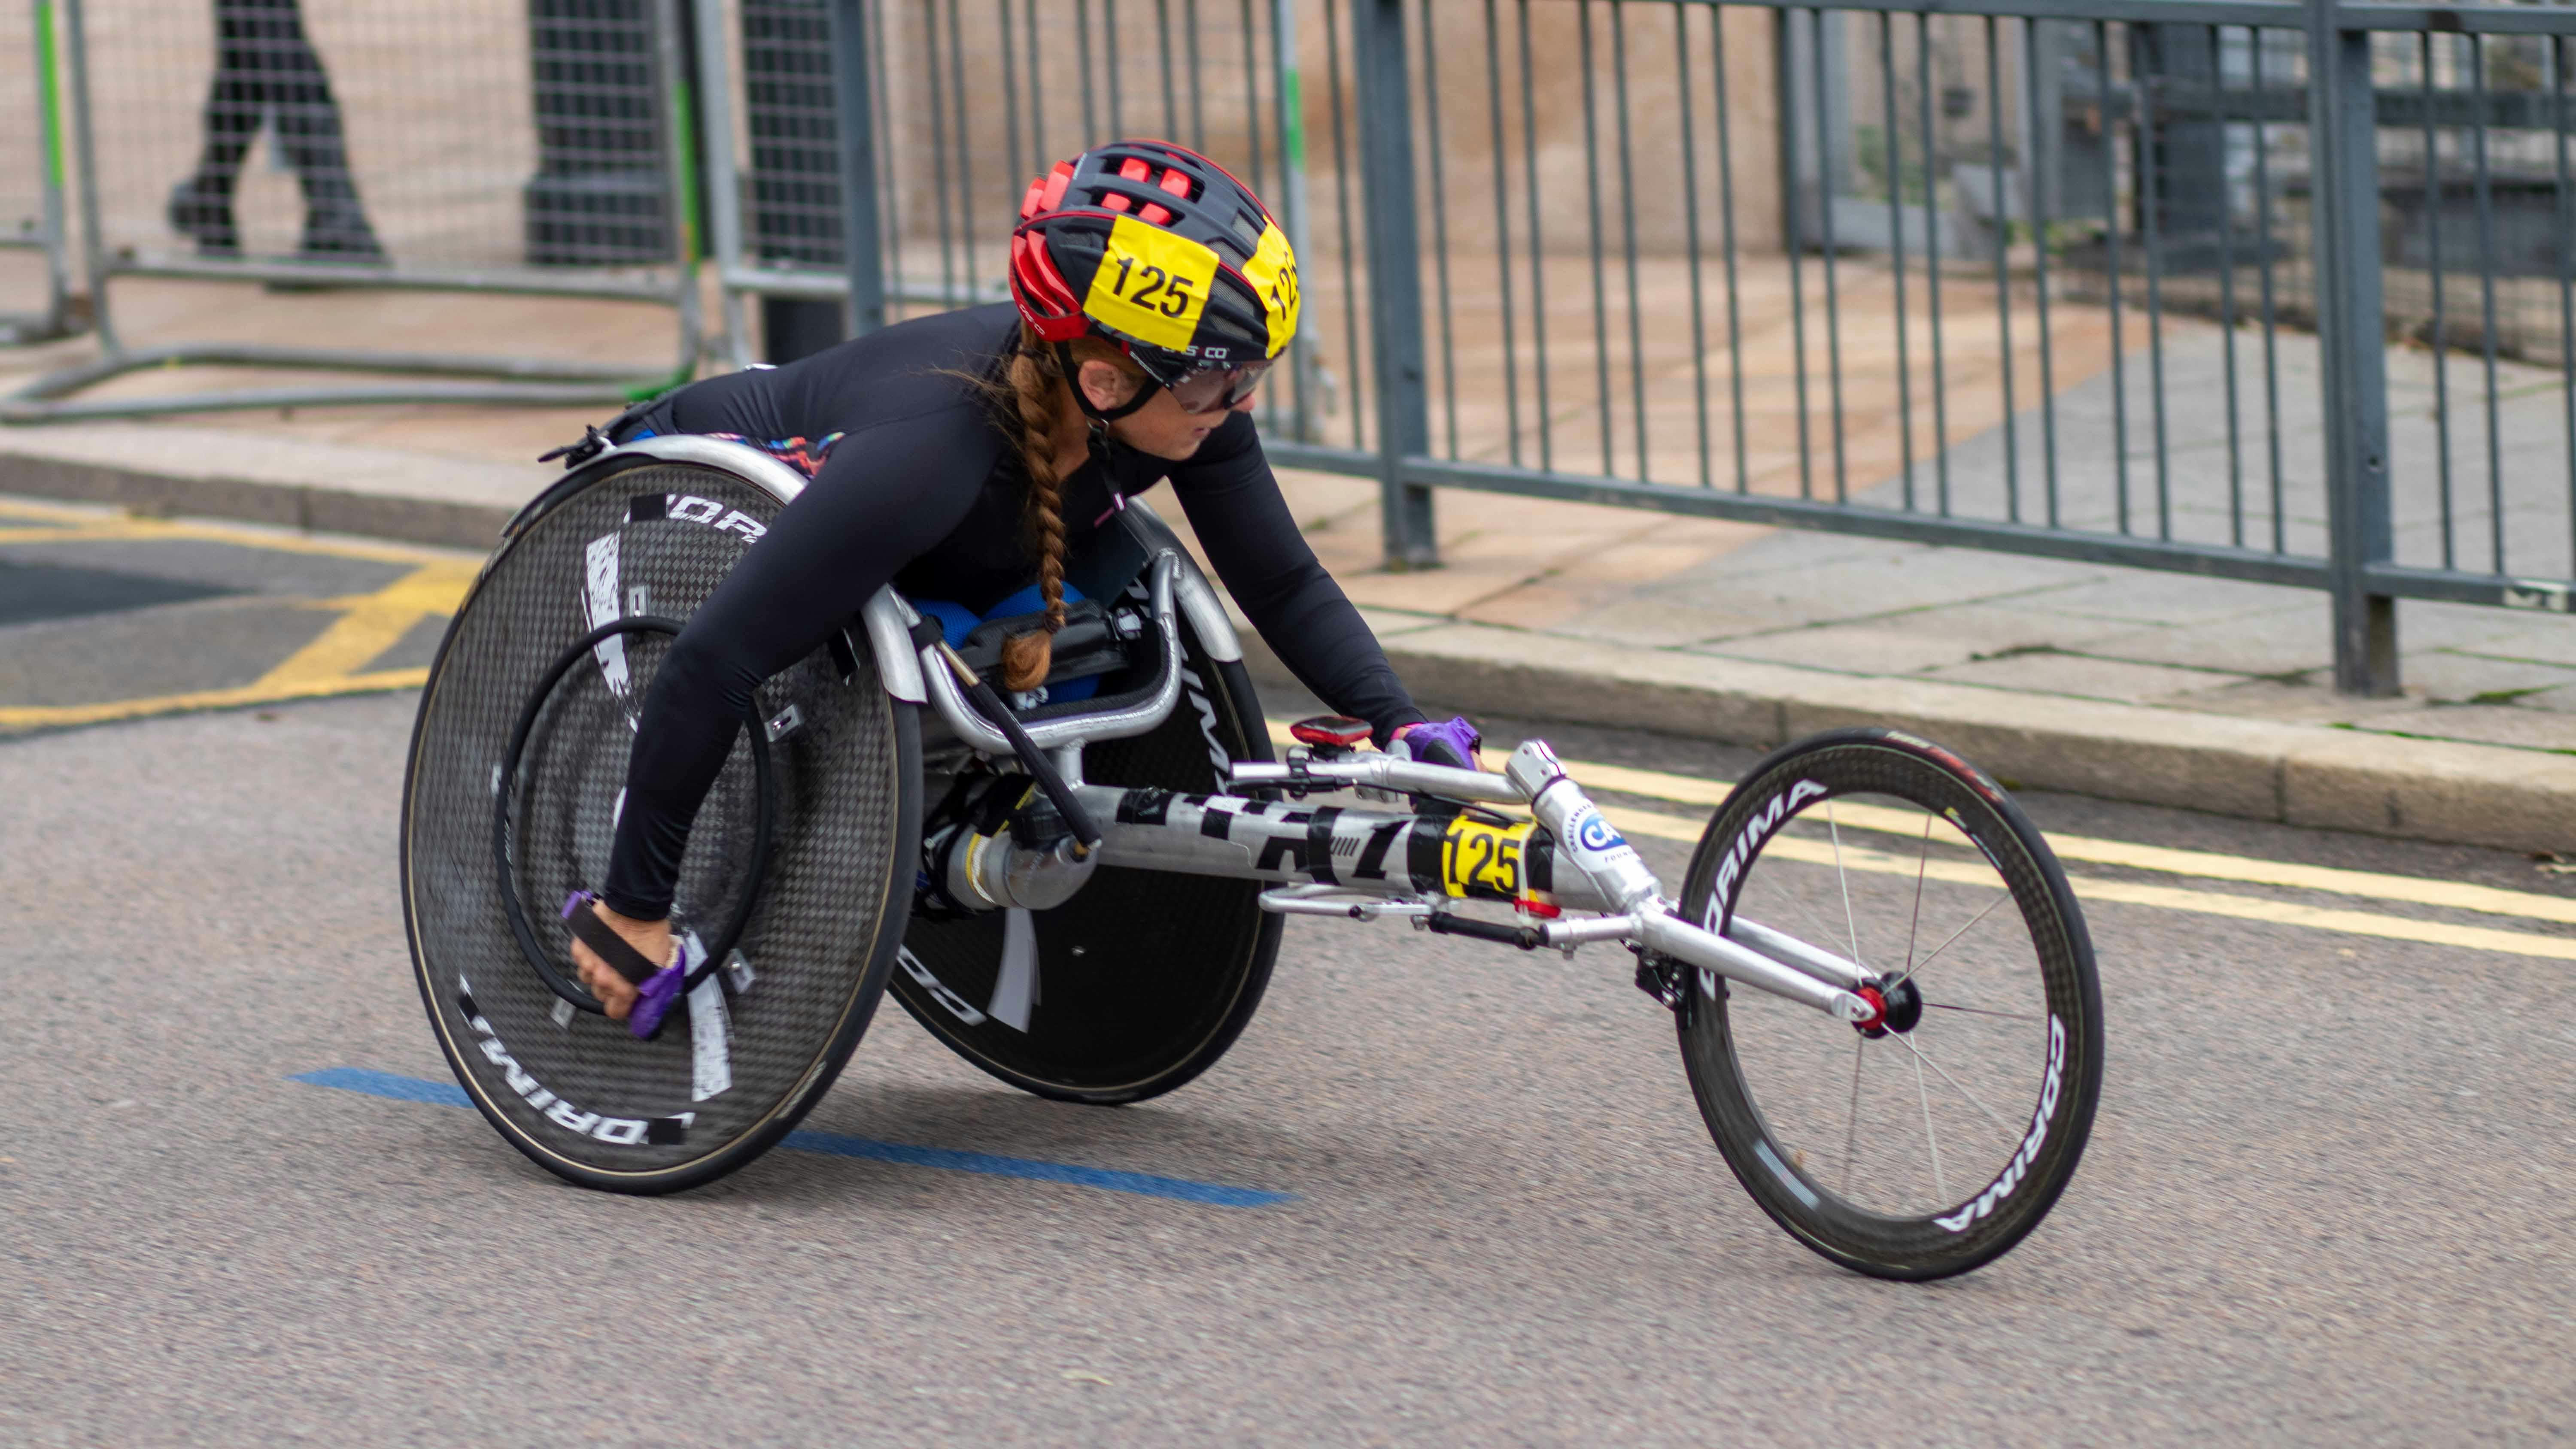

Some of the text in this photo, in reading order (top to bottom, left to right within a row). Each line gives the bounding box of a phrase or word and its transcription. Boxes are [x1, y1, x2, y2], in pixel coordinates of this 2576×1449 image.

[1112, 256, 1194, 318] 125
[1444, 828, 1520, 893] 125
[1585, 820, 1622, 847] CA
[457, 973, 696, 1145] ORIM
[1933, 1013, 2065, 1231] CORIMA
